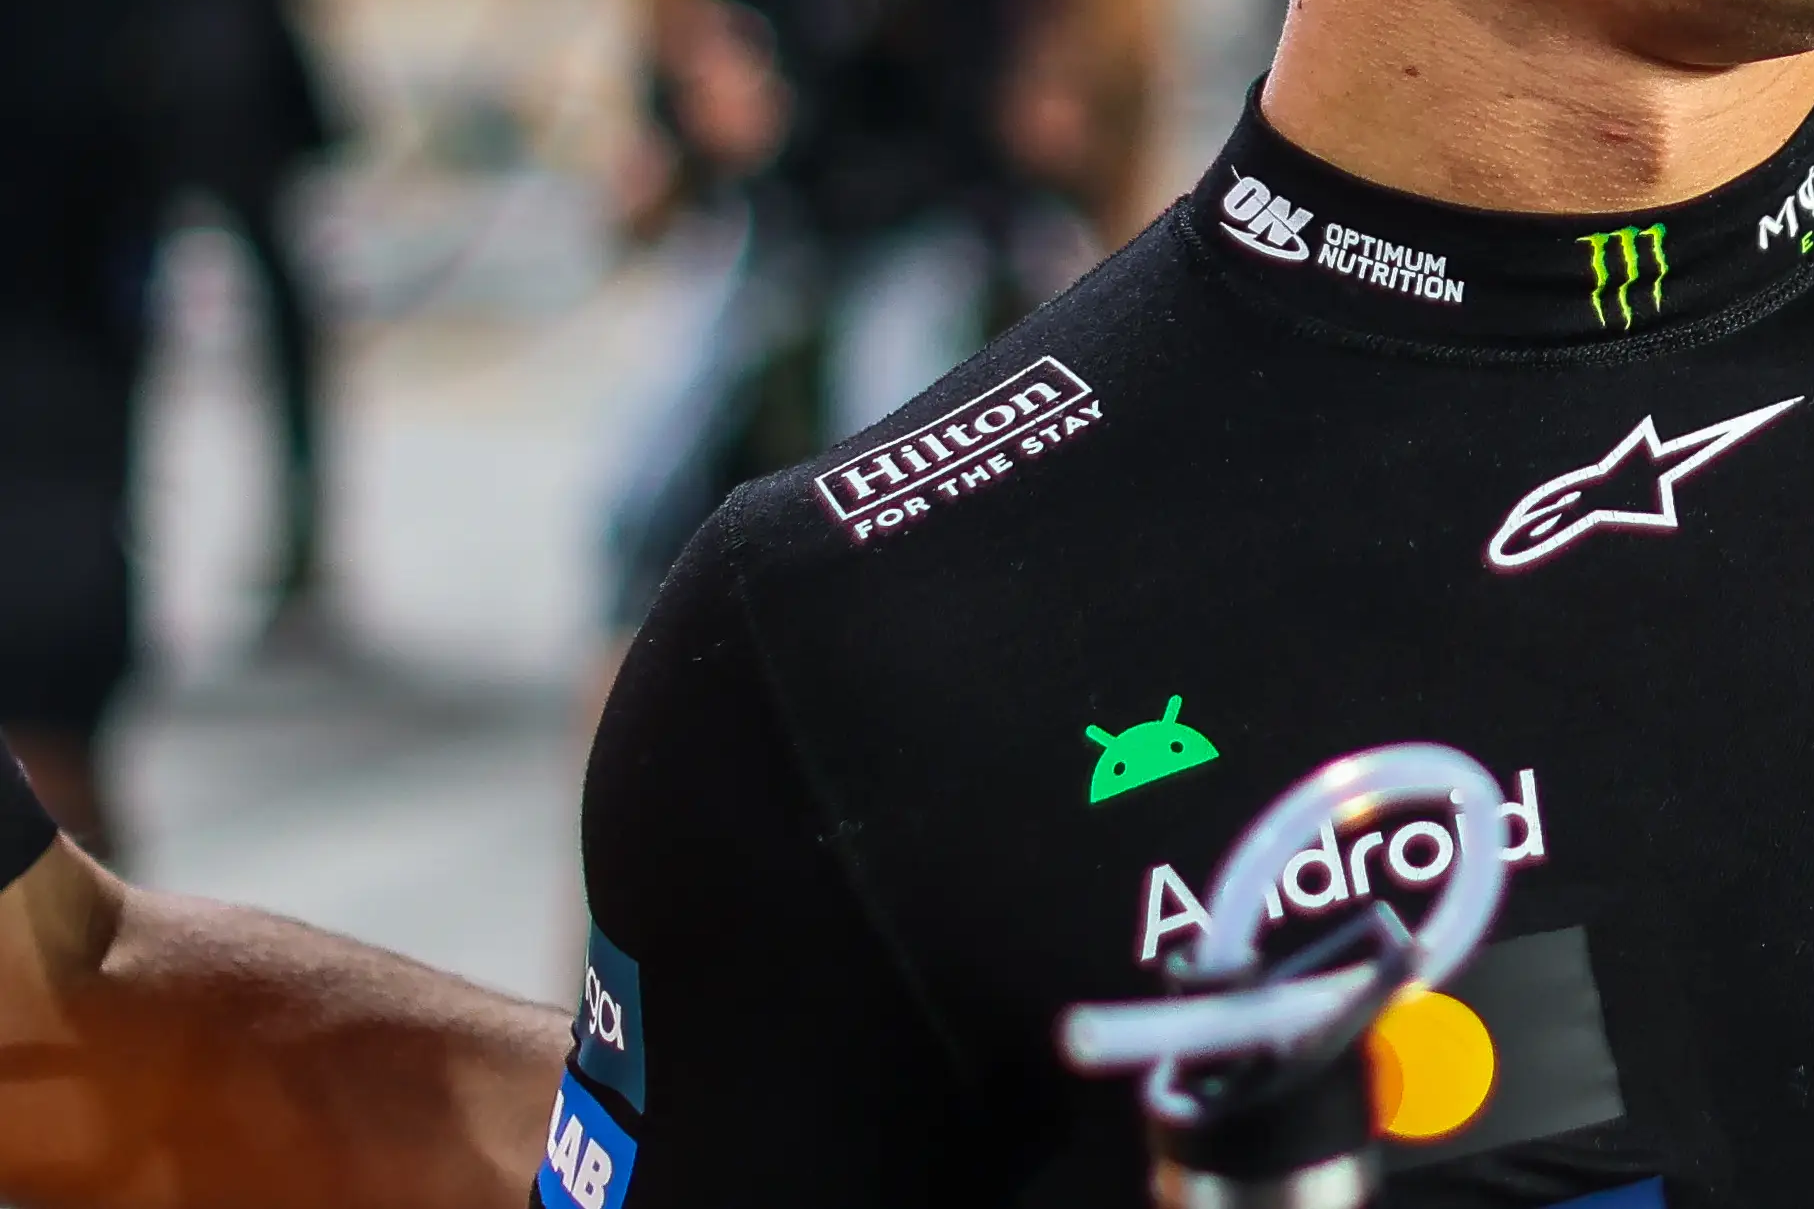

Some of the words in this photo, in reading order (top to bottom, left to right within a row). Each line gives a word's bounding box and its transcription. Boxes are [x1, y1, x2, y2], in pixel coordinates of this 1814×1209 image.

[1223, 176, 1314, 247] ON
[1326, 223, 1447, 278] OPTIMUM
[1317, 244, 1465, 303] NUTRITION
[841, 382, 1062, 500] Hilton
[854, 496, 931, 540] FOR
[937, 452, 1014, 497] THE
[1020, 399, 1104, 456] STAY
[1140, 768, 1545, 961] Adroid
